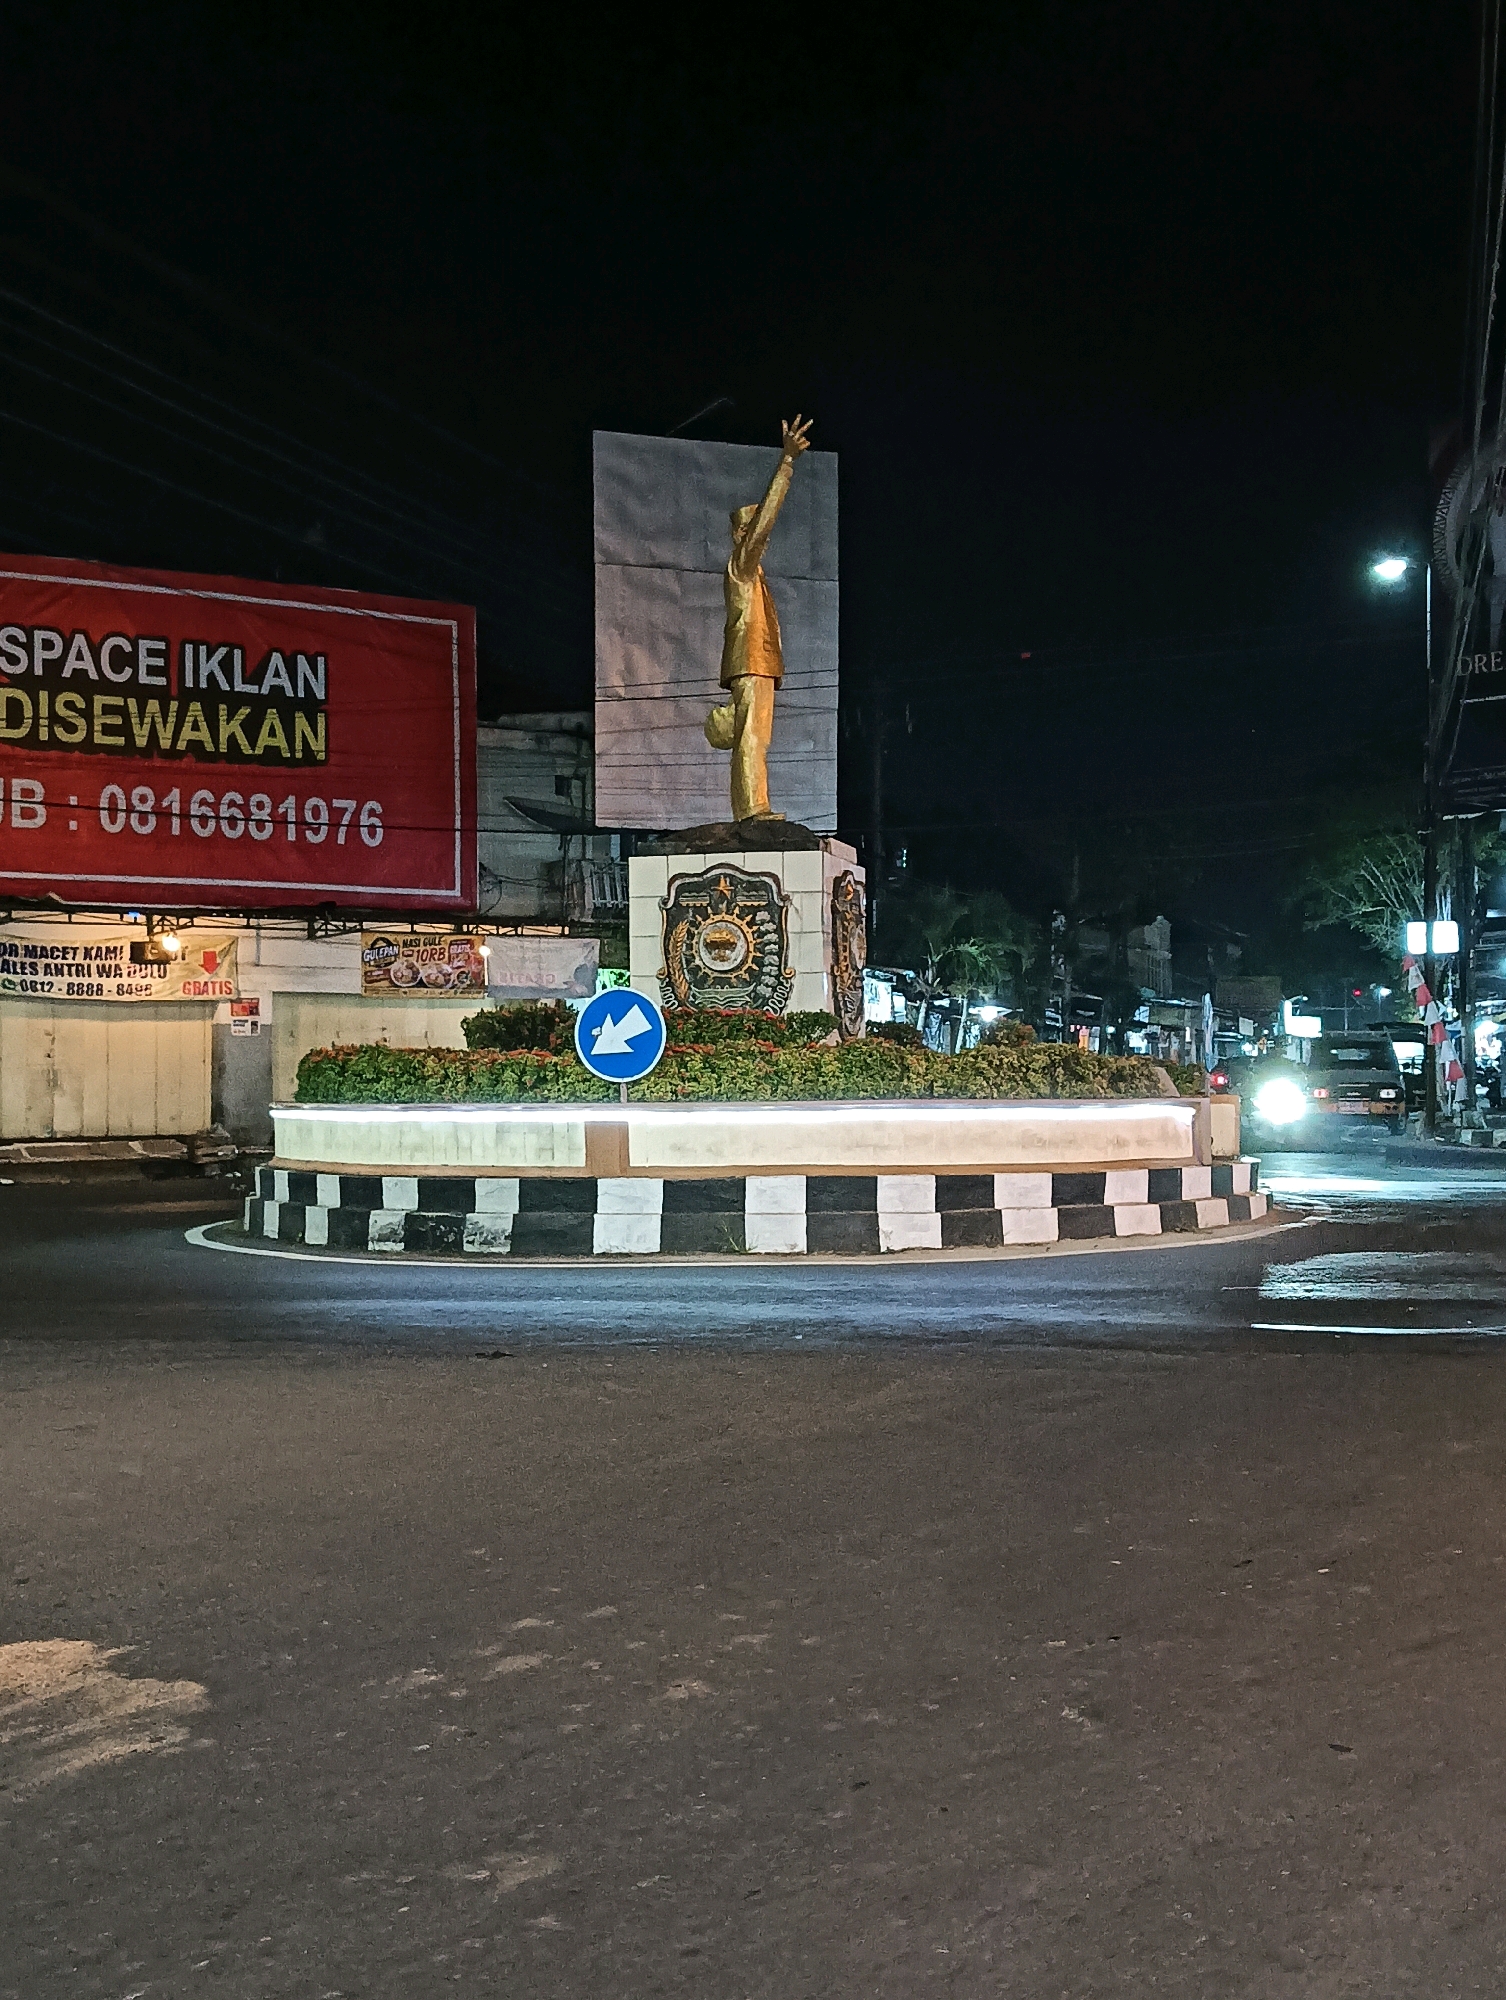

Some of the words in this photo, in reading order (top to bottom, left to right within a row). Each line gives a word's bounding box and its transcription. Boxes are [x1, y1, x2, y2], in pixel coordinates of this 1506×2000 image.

[0, 626, 167, 686] SPACE
[183, 643, 326, 700] IKLAN
[0, 687, 326, 761] DISEWAKAN
[0, 778, 47, 829] B
[100, 783, 385, 848] 0816681976
[24, 944, 79, 961] MACET
[363, 945, 399, 962] GULEPAN
[44, 962, 92, 978] ANTRI
[96, 963, 123, 979] WA
[182, 980, 233, 996] GRATIS
